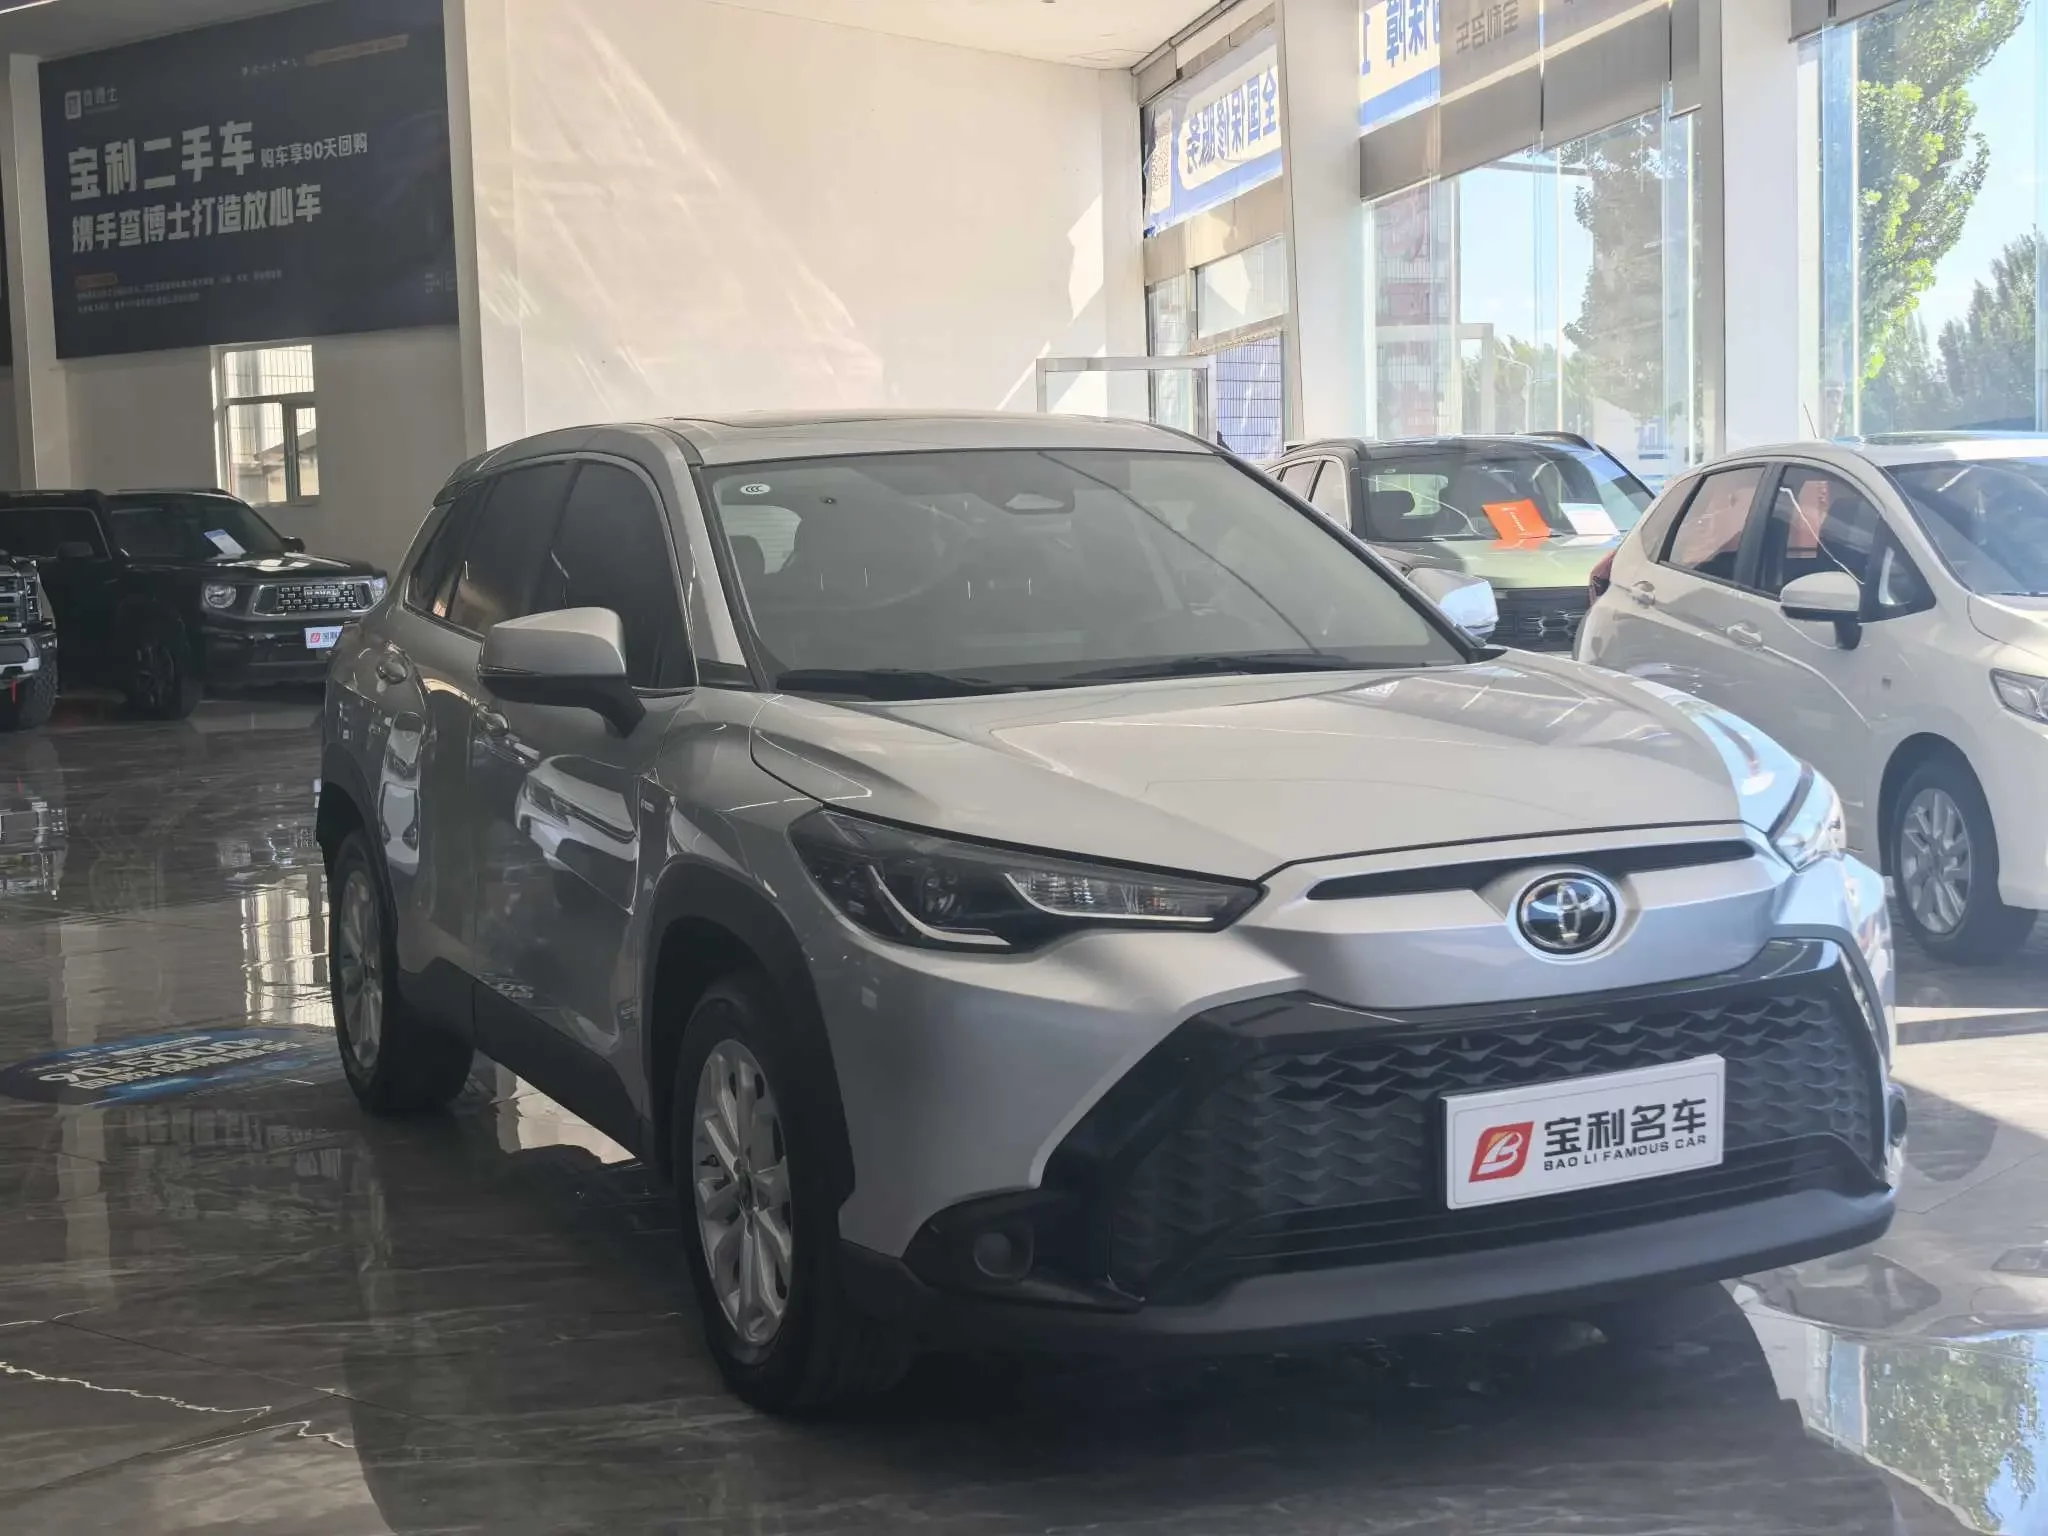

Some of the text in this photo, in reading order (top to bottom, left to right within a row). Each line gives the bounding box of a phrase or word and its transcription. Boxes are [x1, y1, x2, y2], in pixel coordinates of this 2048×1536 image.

[68, 120, 369, 201] 宝利二手车 购车享90天回购
[71, 183, 322, 254] 携手查博士打造放心车
[1544, 1098, 1707, 1158] 宝利名车
[1544, 1134, 1707, 1171] BAO LI FAMOUS CAR
